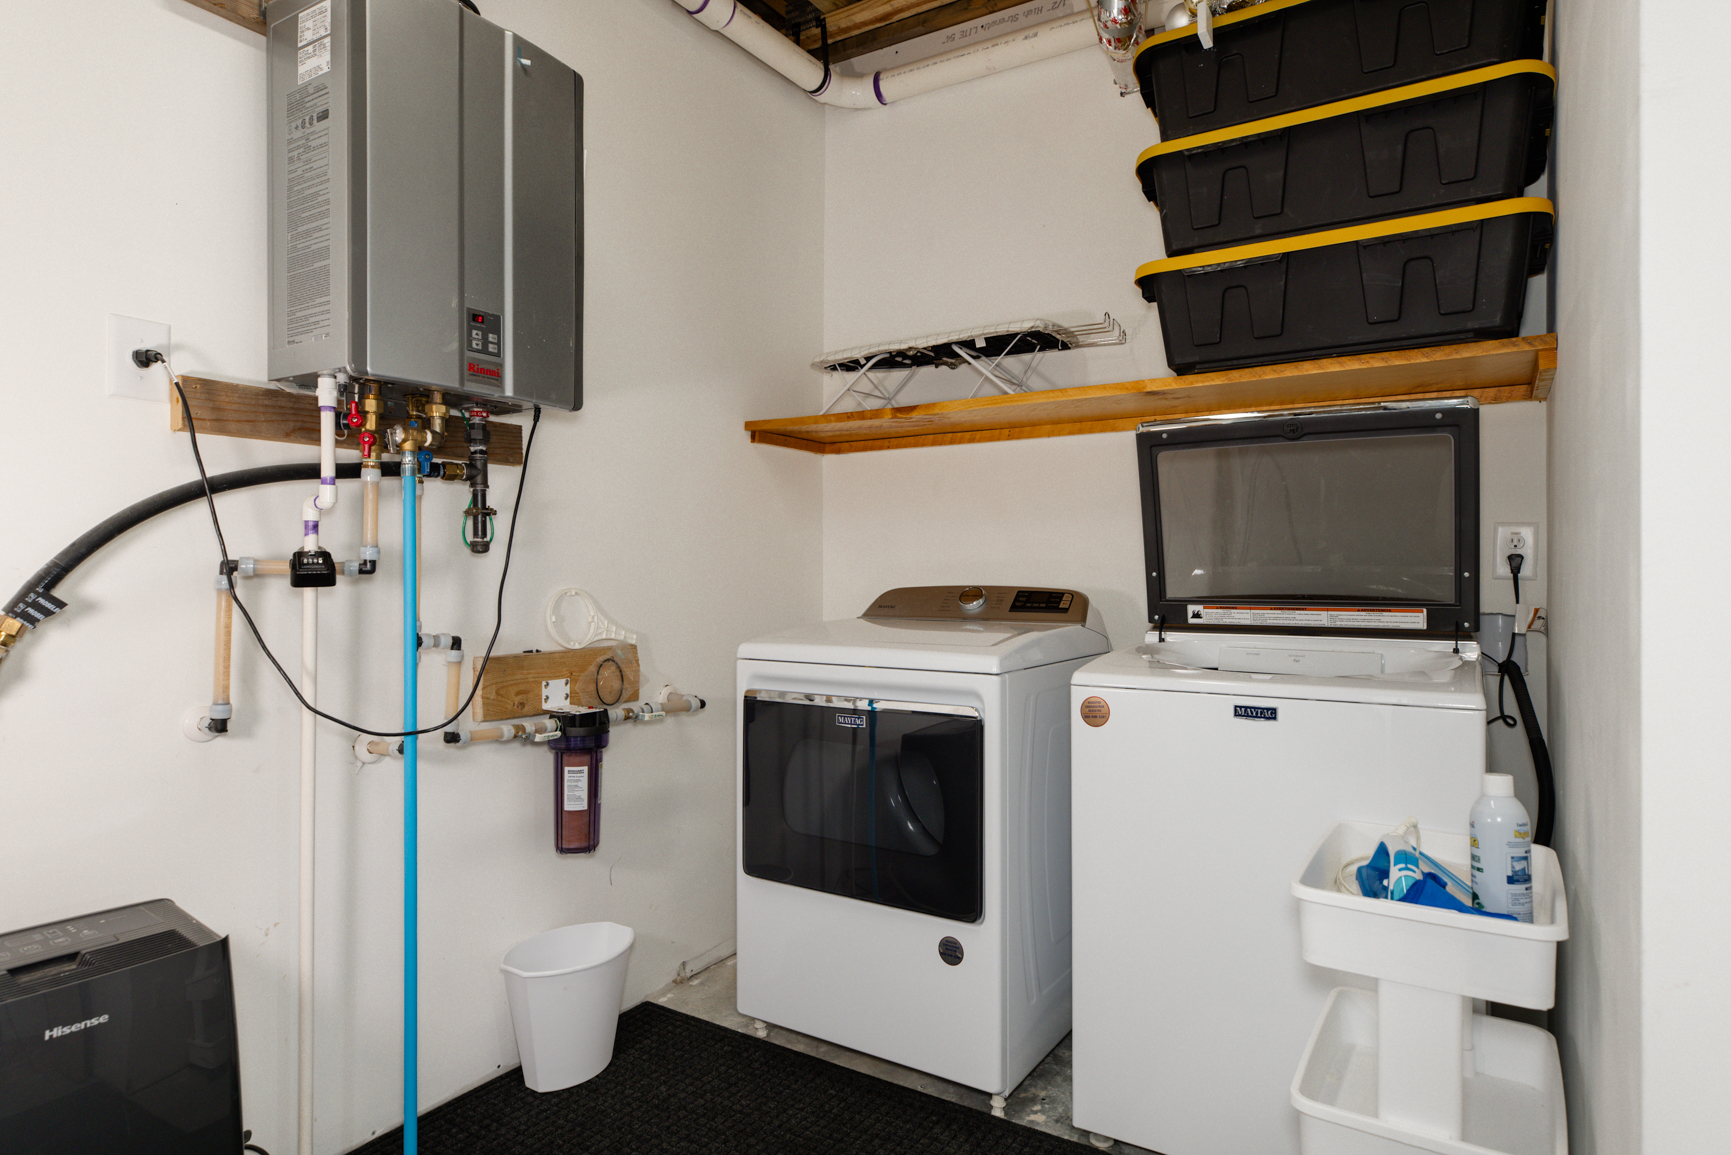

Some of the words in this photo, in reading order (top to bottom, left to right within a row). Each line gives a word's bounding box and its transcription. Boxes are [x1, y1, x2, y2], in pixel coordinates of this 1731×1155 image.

[959, 26, 978, 38] LITE
[468, 362, 500, 378] Rinnai
[1236, 707, 1276, 718] MAYTAG
[838, 716, 864, 725] MAYTAG
[44, 1014, 109, 1041] Hisense
